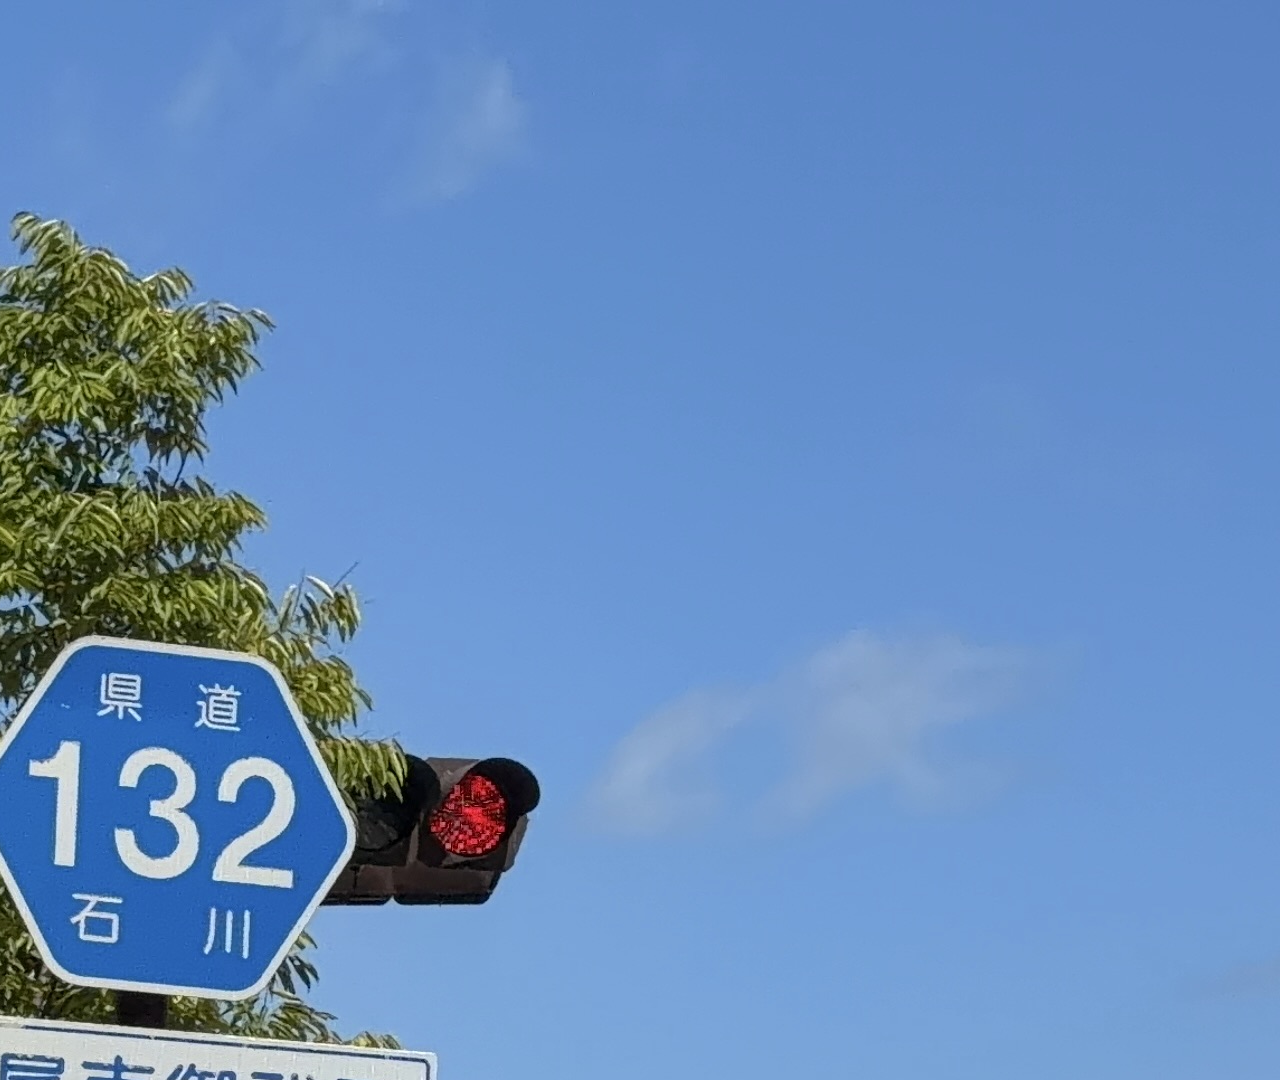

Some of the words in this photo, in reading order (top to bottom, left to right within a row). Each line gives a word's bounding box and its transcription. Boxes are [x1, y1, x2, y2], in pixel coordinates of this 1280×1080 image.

[97, 672, 243, 732] 県道
[28, 740, 298, 890] 132
[70, 892, 251, 960] 石川
